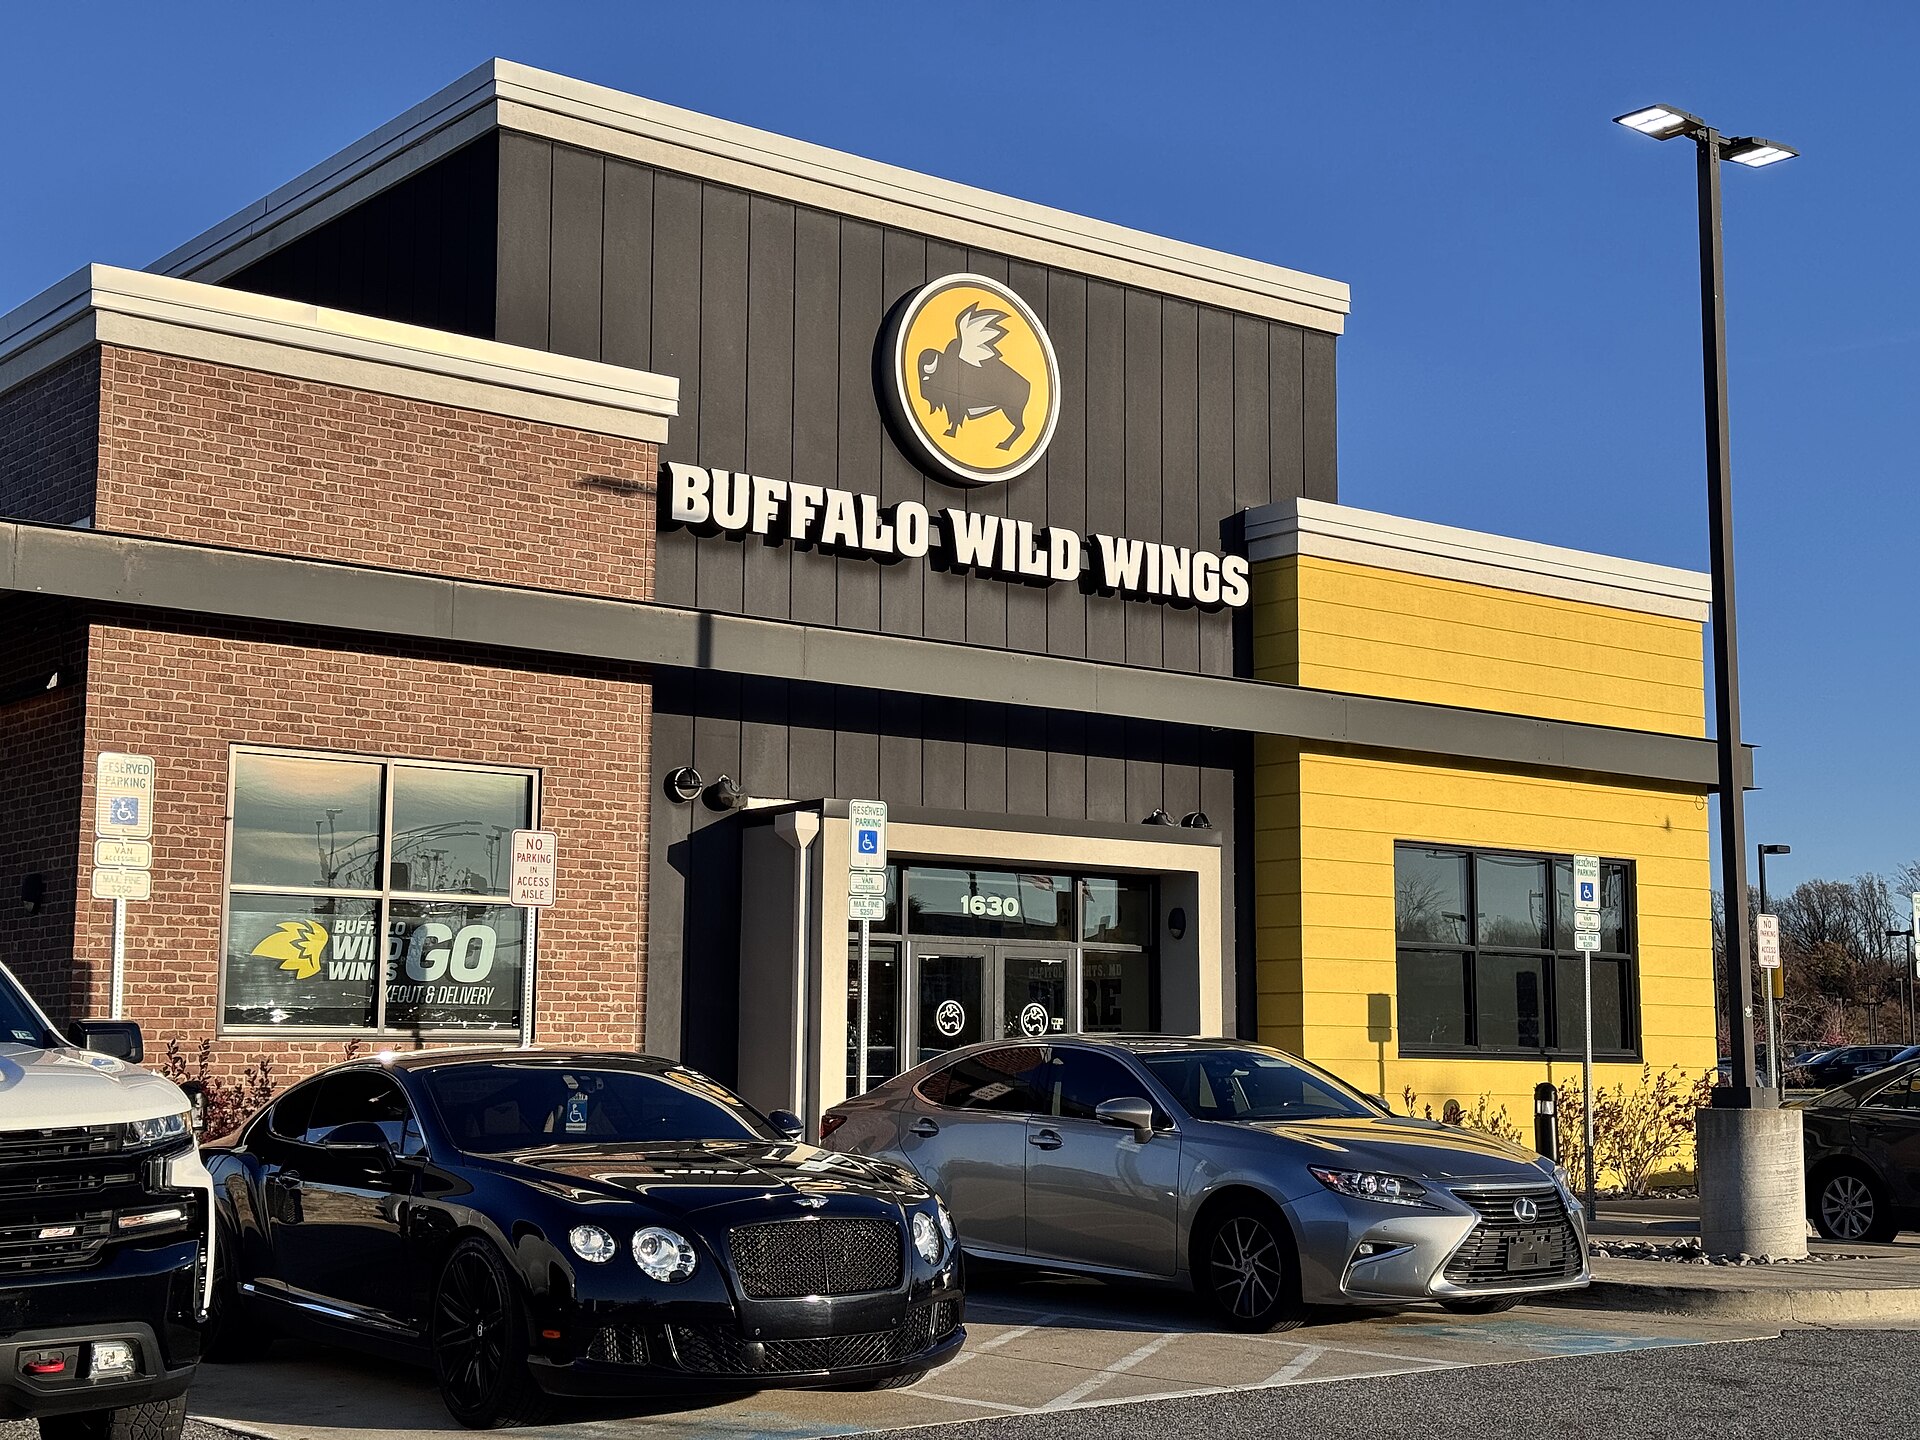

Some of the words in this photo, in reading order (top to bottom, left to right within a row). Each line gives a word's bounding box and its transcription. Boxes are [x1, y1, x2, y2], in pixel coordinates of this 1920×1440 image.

[668, 461, 929, 558] BUFFALO
[947, 508, 1081, 582] WILD
[1096, 533, 1249, 607] WINGS
[105, 776, 146, 789] PARKING
[853, 805, 885, 817] RESERVED
[855, 817, 882, 828] PARKING
[114, 846, 133, 855] VAN
[526, 838, 543, 851] NO
[516, 852, 552, 864] PARKING
[516, 876, 550, 887] ACCESS
[521, 889, 545, 900] AISLE
[860, 908, 874, 916] $250
[961, 895, 1019, 917] 1630
[334, 919, 406, 935] BUFFLO
[1763, 920, 1771, 928] NO
[405, 922, 497, 983] GO
[329, 961, 399, 981] WINS
[369, 984, 425, 1003] TKEOUT
[425, 985, 436, 1004] &
[437, 985, 495, 1005] DELIVERY
